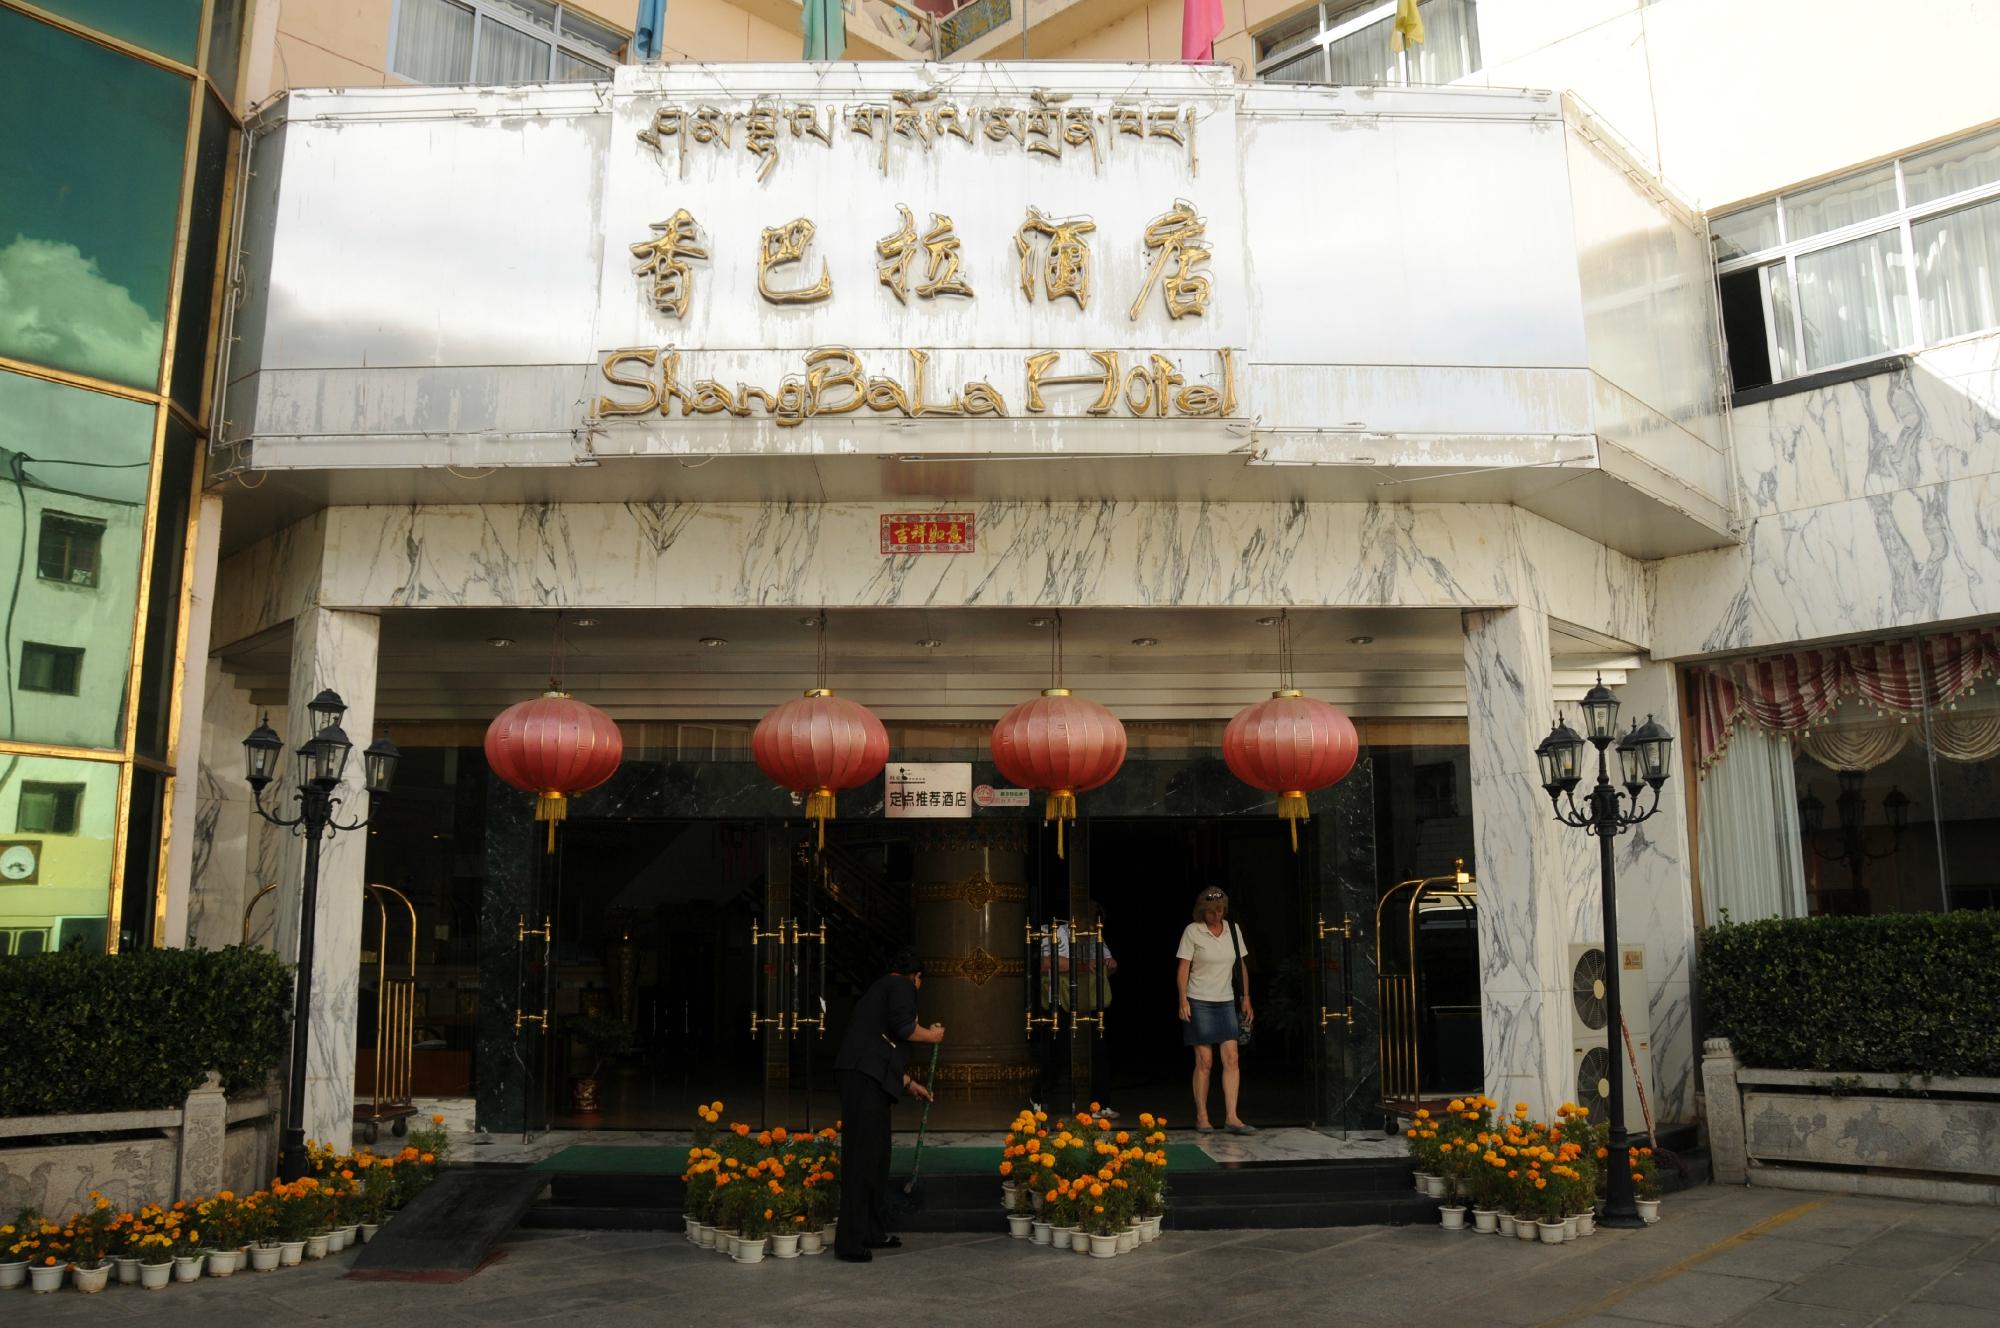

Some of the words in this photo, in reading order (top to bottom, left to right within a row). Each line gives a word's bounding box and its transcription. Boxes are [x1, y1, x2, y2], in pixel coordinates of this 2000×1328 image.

[629, 199, 1212, 321] 香巴拉酒店
[1024, 347, 1239, 418] Hotel
[894, 522, 962, 544] 吉祥如意
[889, 791, 967, 807] 定点推荐酒店
